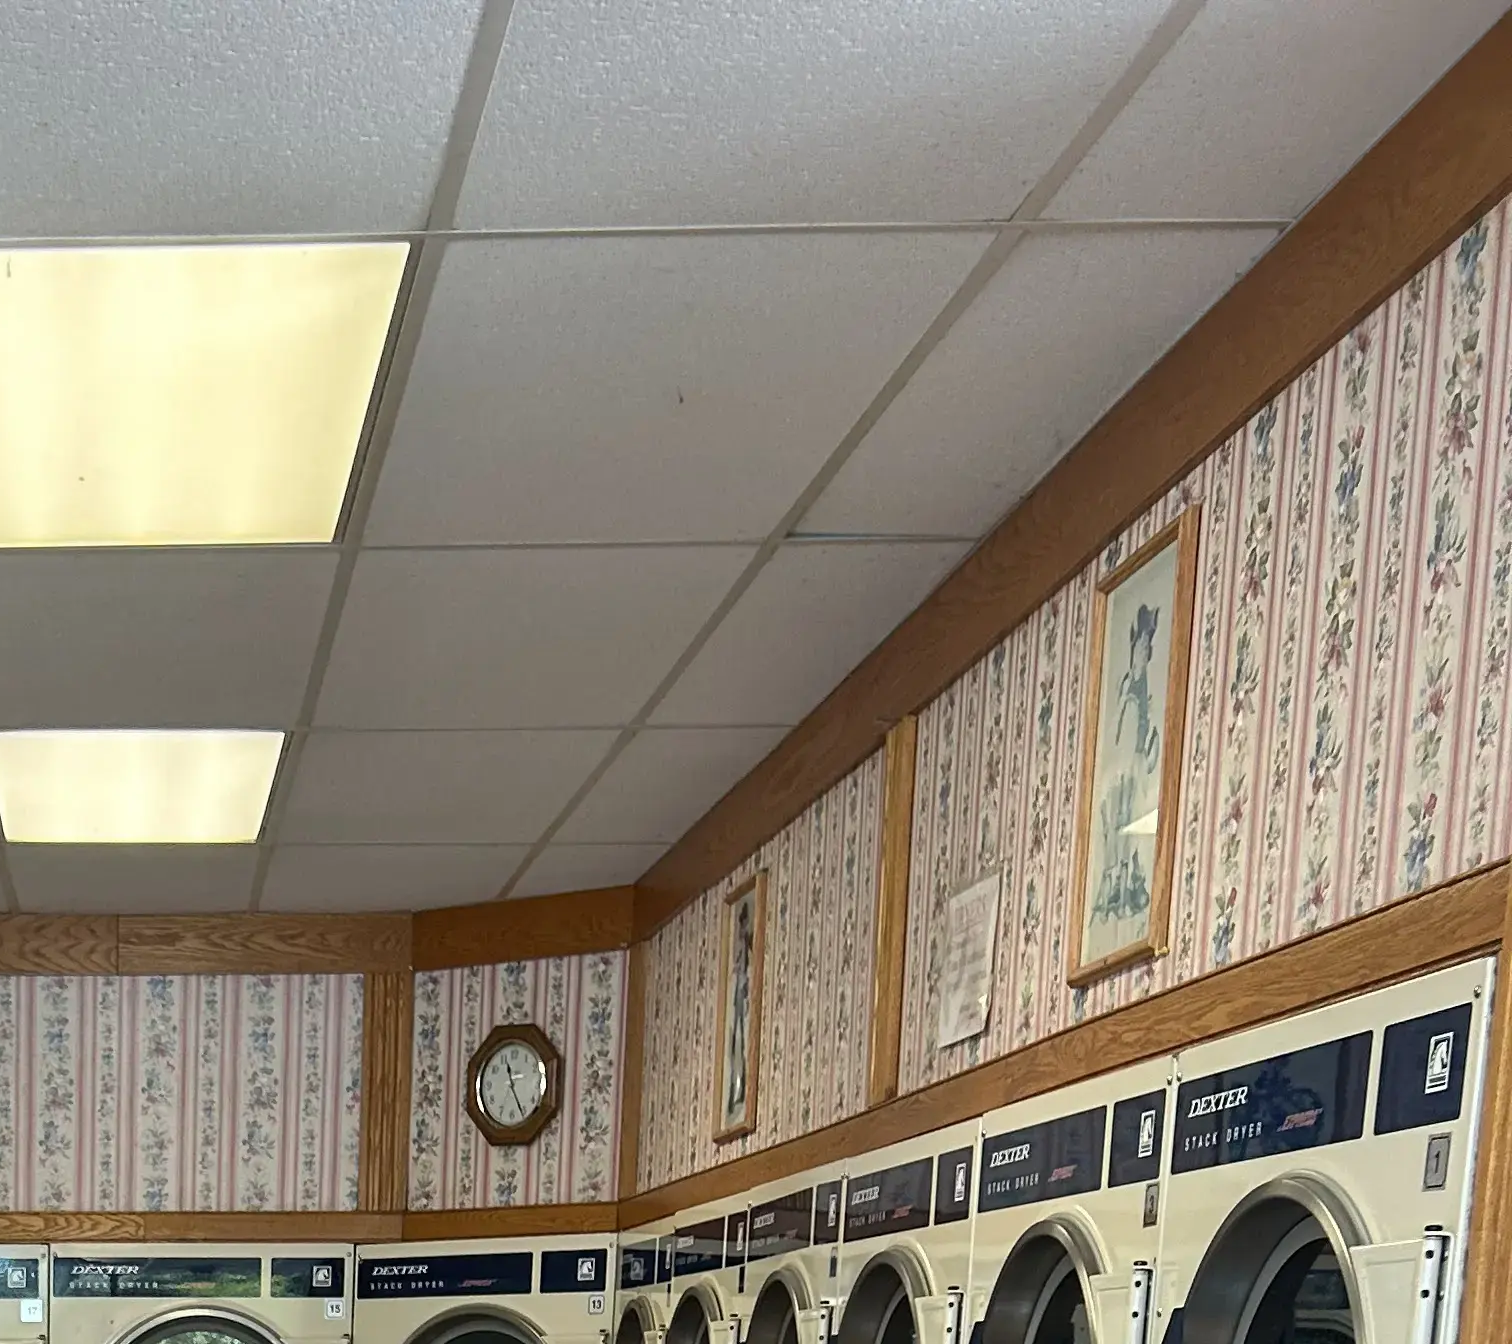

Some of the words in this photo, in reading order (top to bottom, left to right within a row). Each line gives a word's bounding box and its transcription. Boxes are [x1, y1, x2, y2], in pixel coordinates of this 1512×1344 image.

[1188, 1086, 1248, 1118] DEXTER
[1184, 1131, 1218, 1152] STACK
[1226, 1121, 1263, 1143] DRYER
[989, 1143, 1031, 1169] DEXTER
[988, 1177, 1011, 1196] STACK
[1015, 1173, 1040, 1191] DRYER
[70, 1265, 139, 1275] DEXTER
[371, 1264, 428, 1276] DEXTER
[329, 1303, 341, 1315] 15
[591, 1298, 602, 1311] 13
